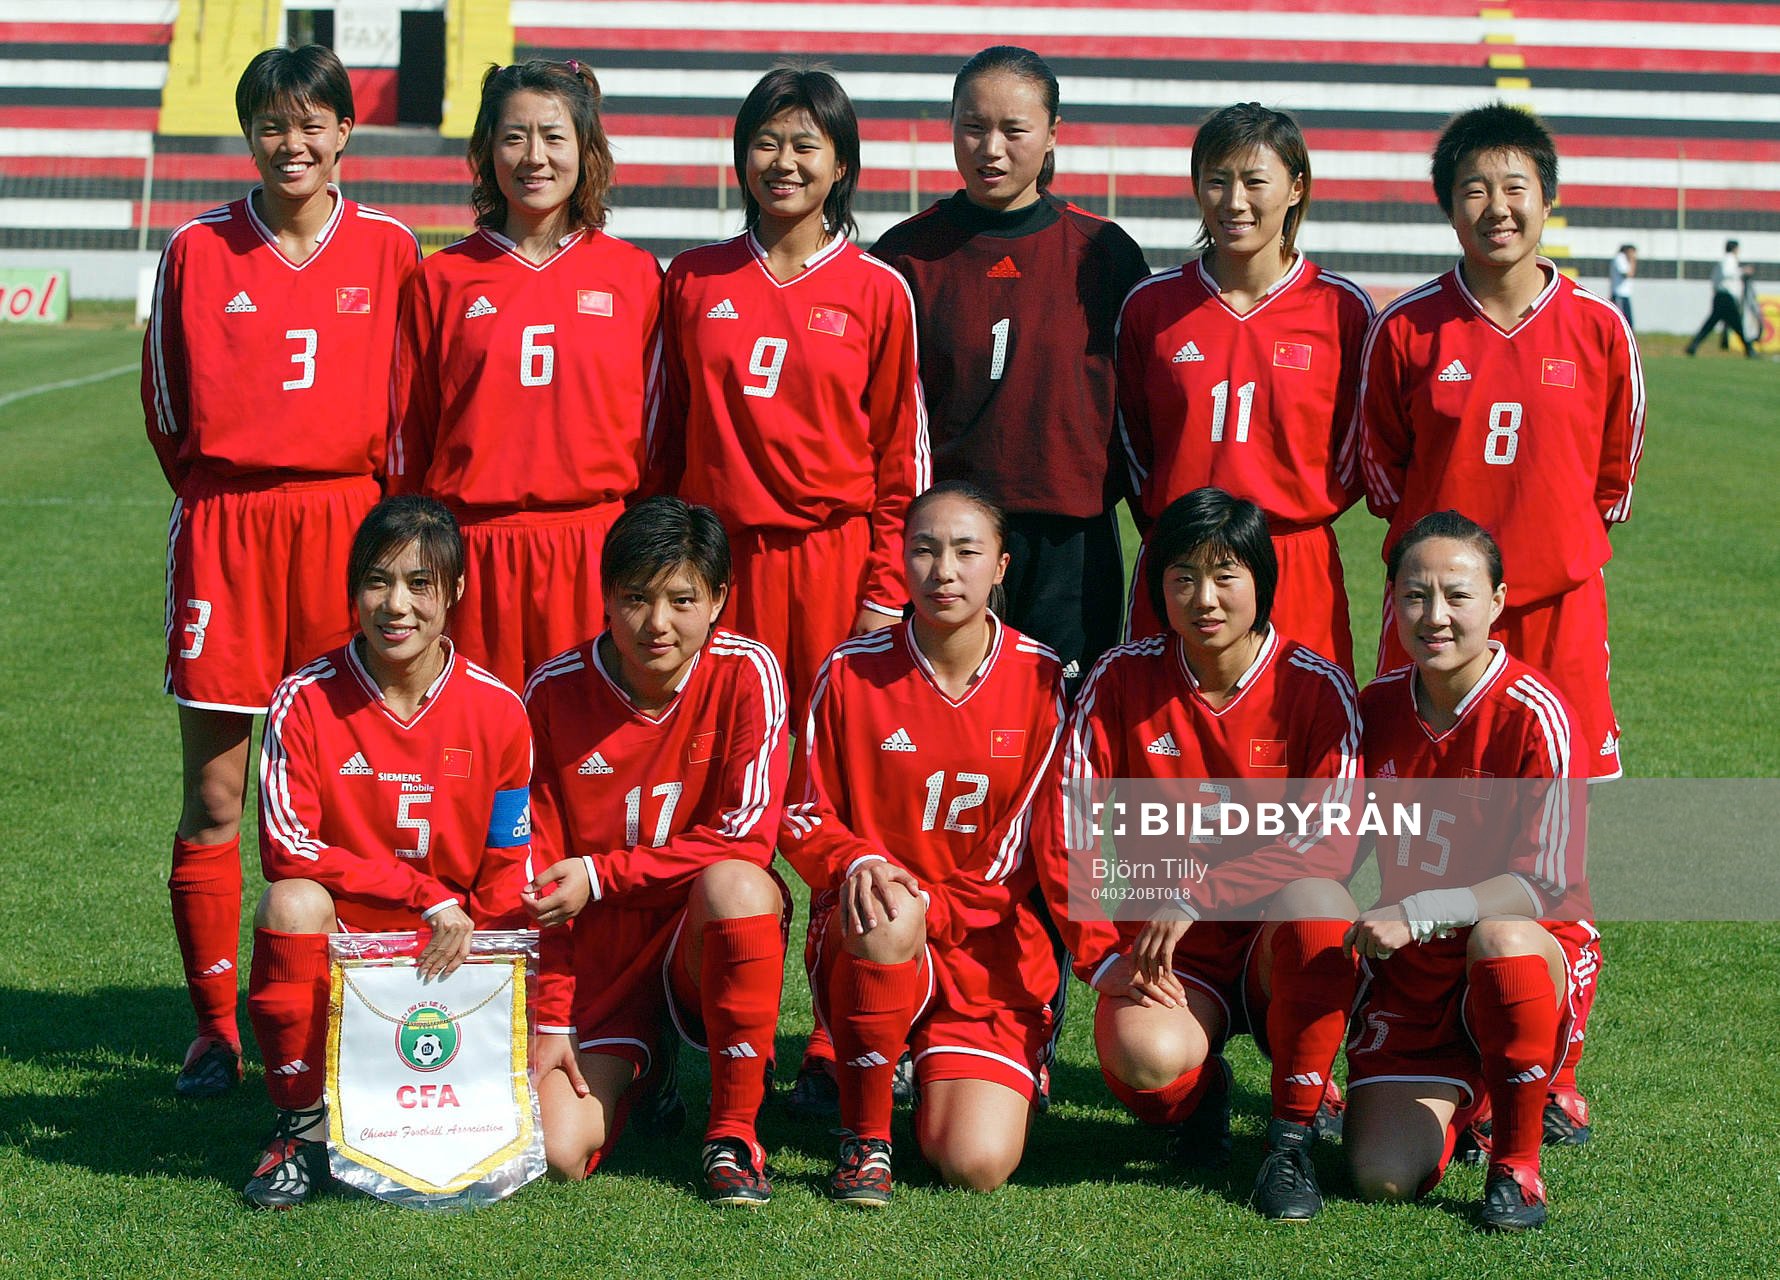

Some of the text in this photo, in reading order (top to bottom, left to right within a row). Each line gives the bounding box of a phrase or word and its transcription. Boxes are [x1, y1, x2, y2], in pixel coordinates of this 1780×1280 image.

[224, 305, 258, 313] adidas
[465, 307, 498, 319] adidas
[706, 311, 740, 320] adidas
[282, 328, 318, 391] 3
[520, 324, 555, 387] 6
[990, 318, 1010, 380] 1
[1172, 353, 1205, 363] adidas
[743, 336, 788, 398] 9
[1438, 372, 1472, 382] adidas
[1210, 380, 1256, 443] 11
[1484, 402, 1523, 465] 8
[180, 598, 212, 659] 3
[880, 742, 918, 752] adidas
[1146, 744, 1181, 757] adidas
[338, 766, 374, 776] adidas
[377, 772, 422, 783] SIEMENS
[577, 766, 614, 775] adidas
[921, 770, 990, 834] 12
[624, 781, 683, 848] 17
[395, 793, 432, 859] 5
[396, 1083, 461, 1109] CFA
[360, 1123, 504, 1141] Chinese Football Association
